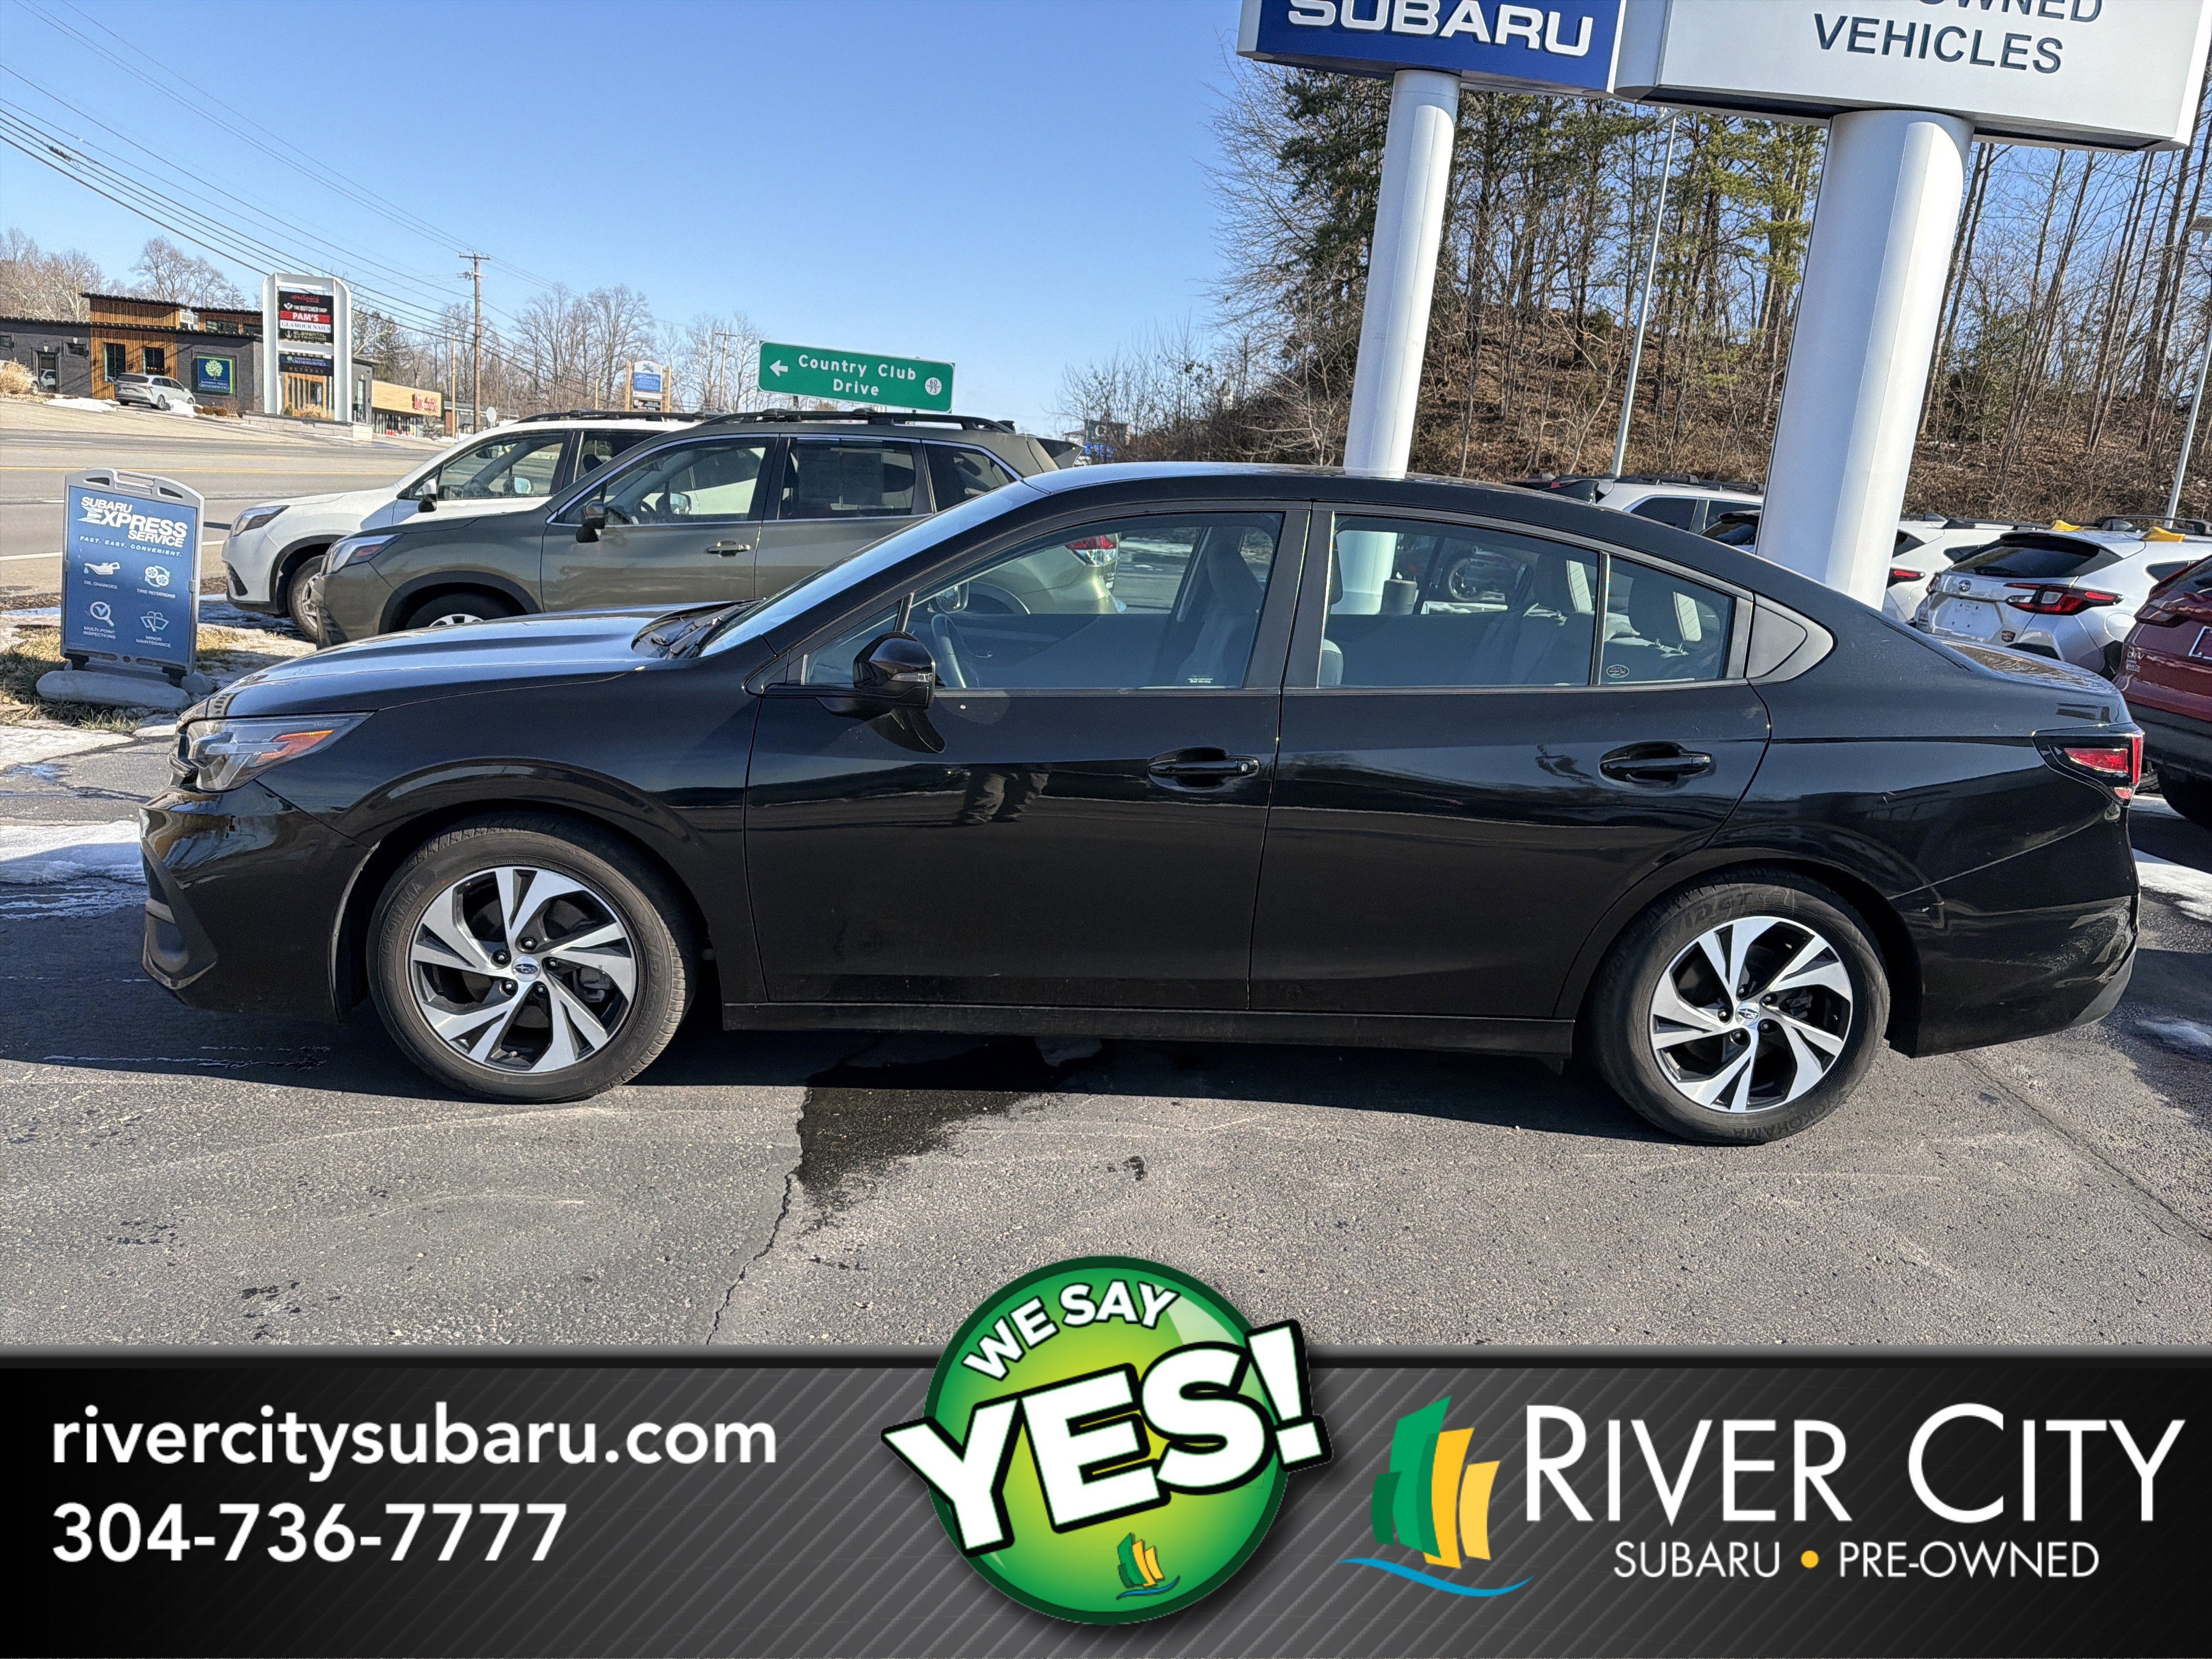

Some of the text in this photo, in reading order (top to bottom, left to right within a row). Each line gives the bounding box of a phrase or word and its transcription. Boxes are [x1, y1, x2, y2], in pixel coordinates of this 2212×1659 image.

[1288, 0, 1593, 56] SUBARU
[1814, 14, 2063, 74] VEHICLES
[292, 312, 318, 321] PAM'S
[798, 354, 916, 380] Country Club
[833, 379, 879, 396] Drive
[81, 496, 132, 513] SUBARU
[77, 505, 188, 538] EXPRESS
[80, 535, 101, 544] FAST.
[130, 544, 182, 557] CONVENIENT.
[128, 529, 184, 548] SERVICE
[93, 582, 117, 590] CHANGES
[148, 590, 176, 599] ROTATIONS
[83, 626, 115, 634] MULTI-POINT
[83, 631, 116, 640] INSPECTIONS
[136, 639, 172, 648] MAINTENANCE
